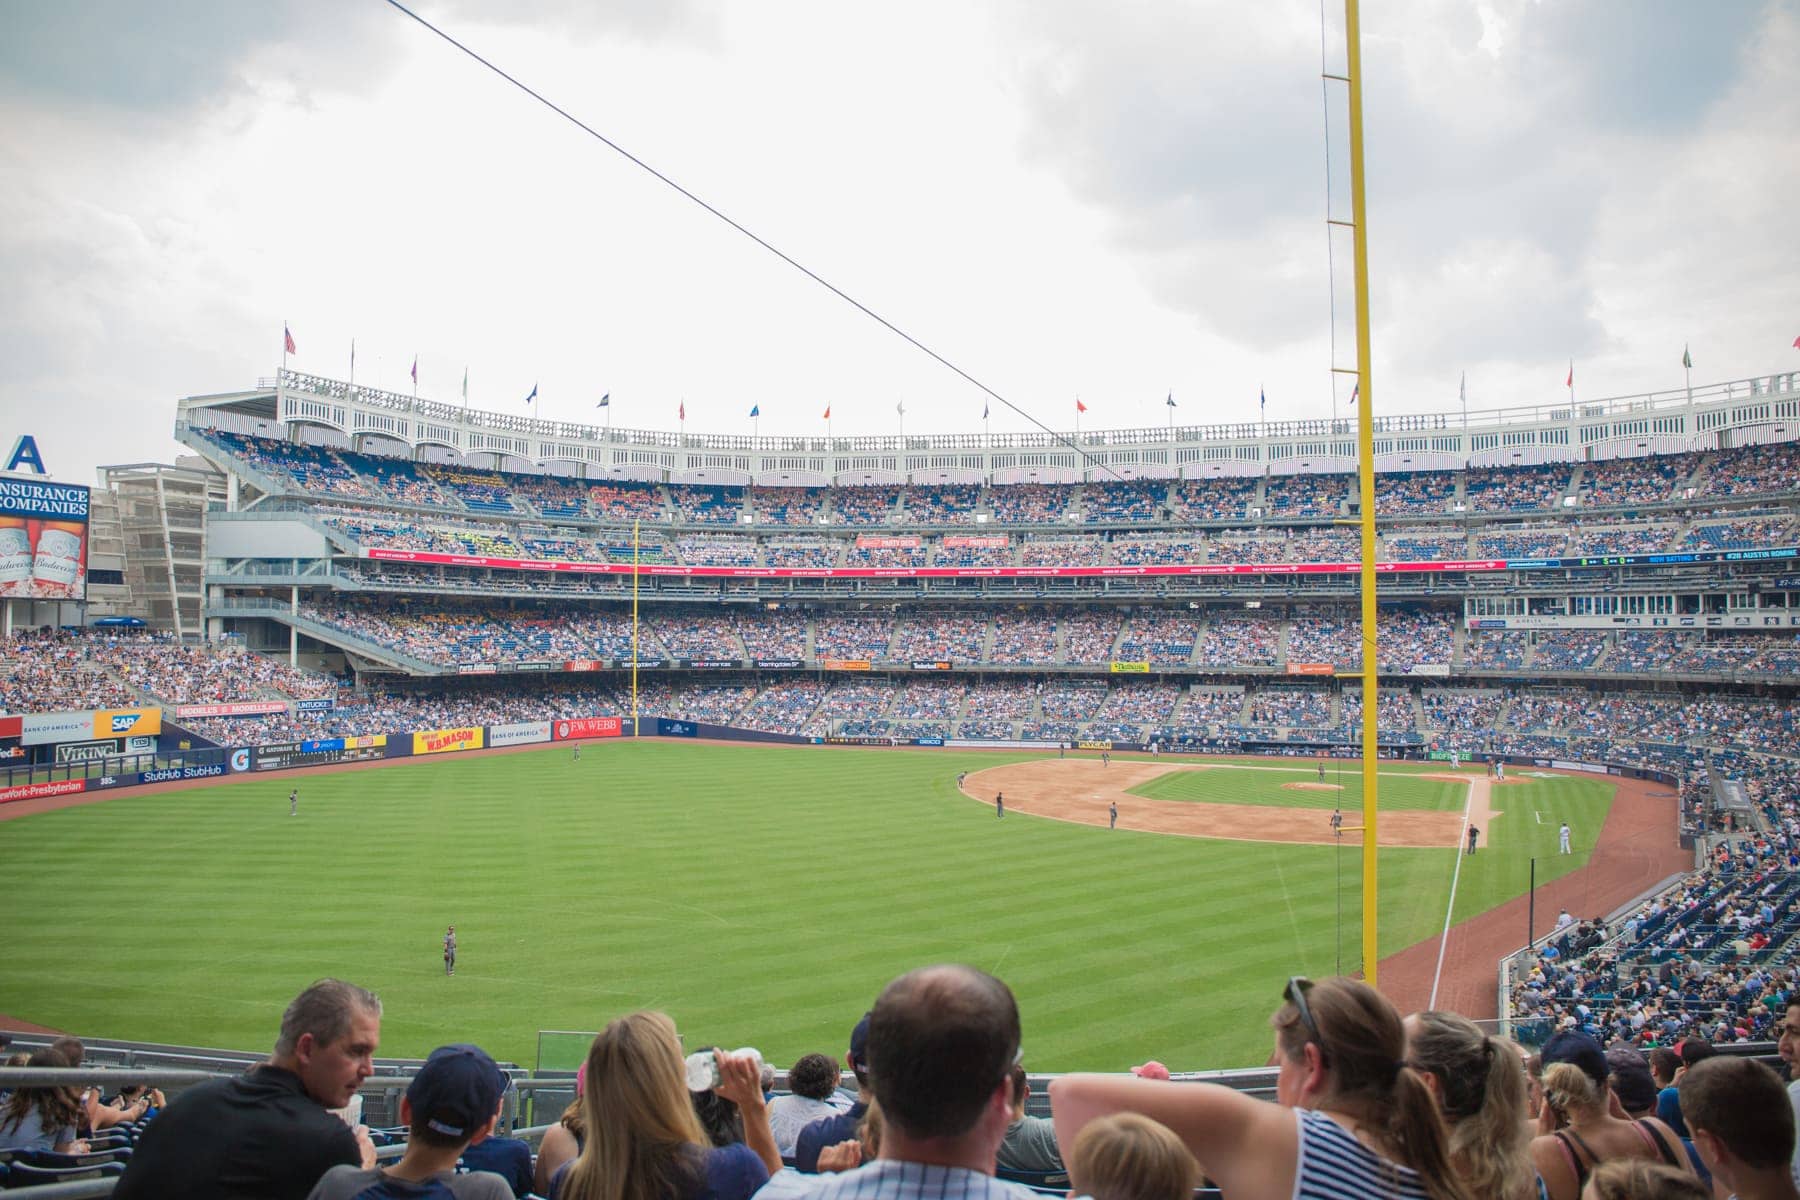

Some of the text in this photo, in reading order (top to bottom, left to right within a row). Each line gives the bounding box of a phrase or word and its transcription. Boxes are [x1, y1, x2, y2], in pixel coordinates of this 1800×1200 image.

[5, 434, 47, 475] A
[112, 717, 135, 729] SAP
[588, 719, 617, 731] WEBB
[515, 729, 538, 737] AMERICA
[61, 745, 114, 763] VIKING
[144, 765, 222, 782] StubHub StubHub
